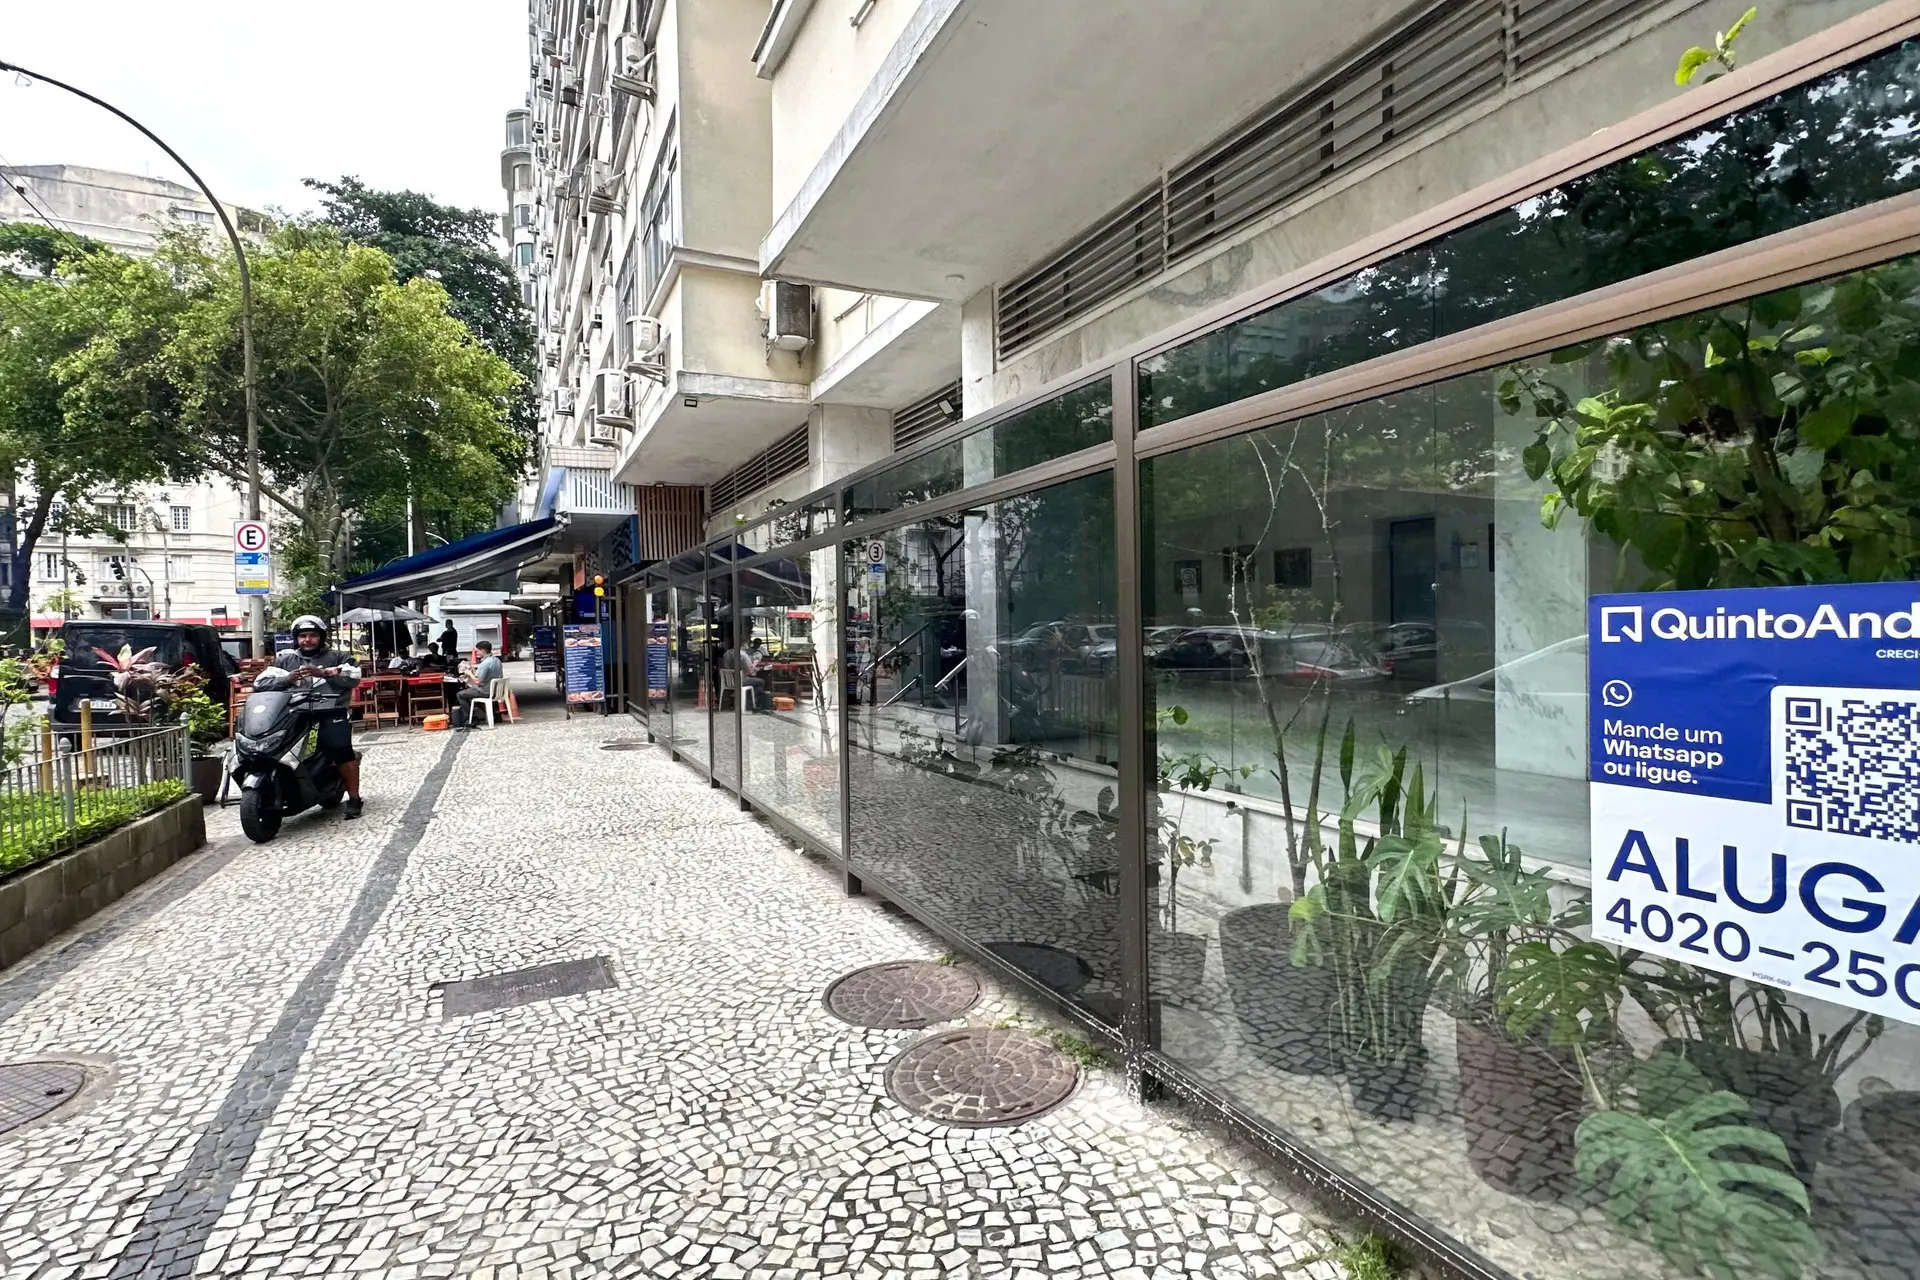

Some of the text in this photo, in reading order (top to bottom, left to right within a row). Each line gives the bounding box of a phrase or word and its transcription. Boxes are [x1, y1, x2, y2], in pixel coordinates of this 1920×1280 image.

[246, 529, 257, 545] E
[1650, 601, 1920, 642] QuintoAnd
[1603, 718, 1723, 745] Mande um
[1603, 738, 1723, 769] Whatsapp
[1603, 760, 1699, 784] ou ligue.
